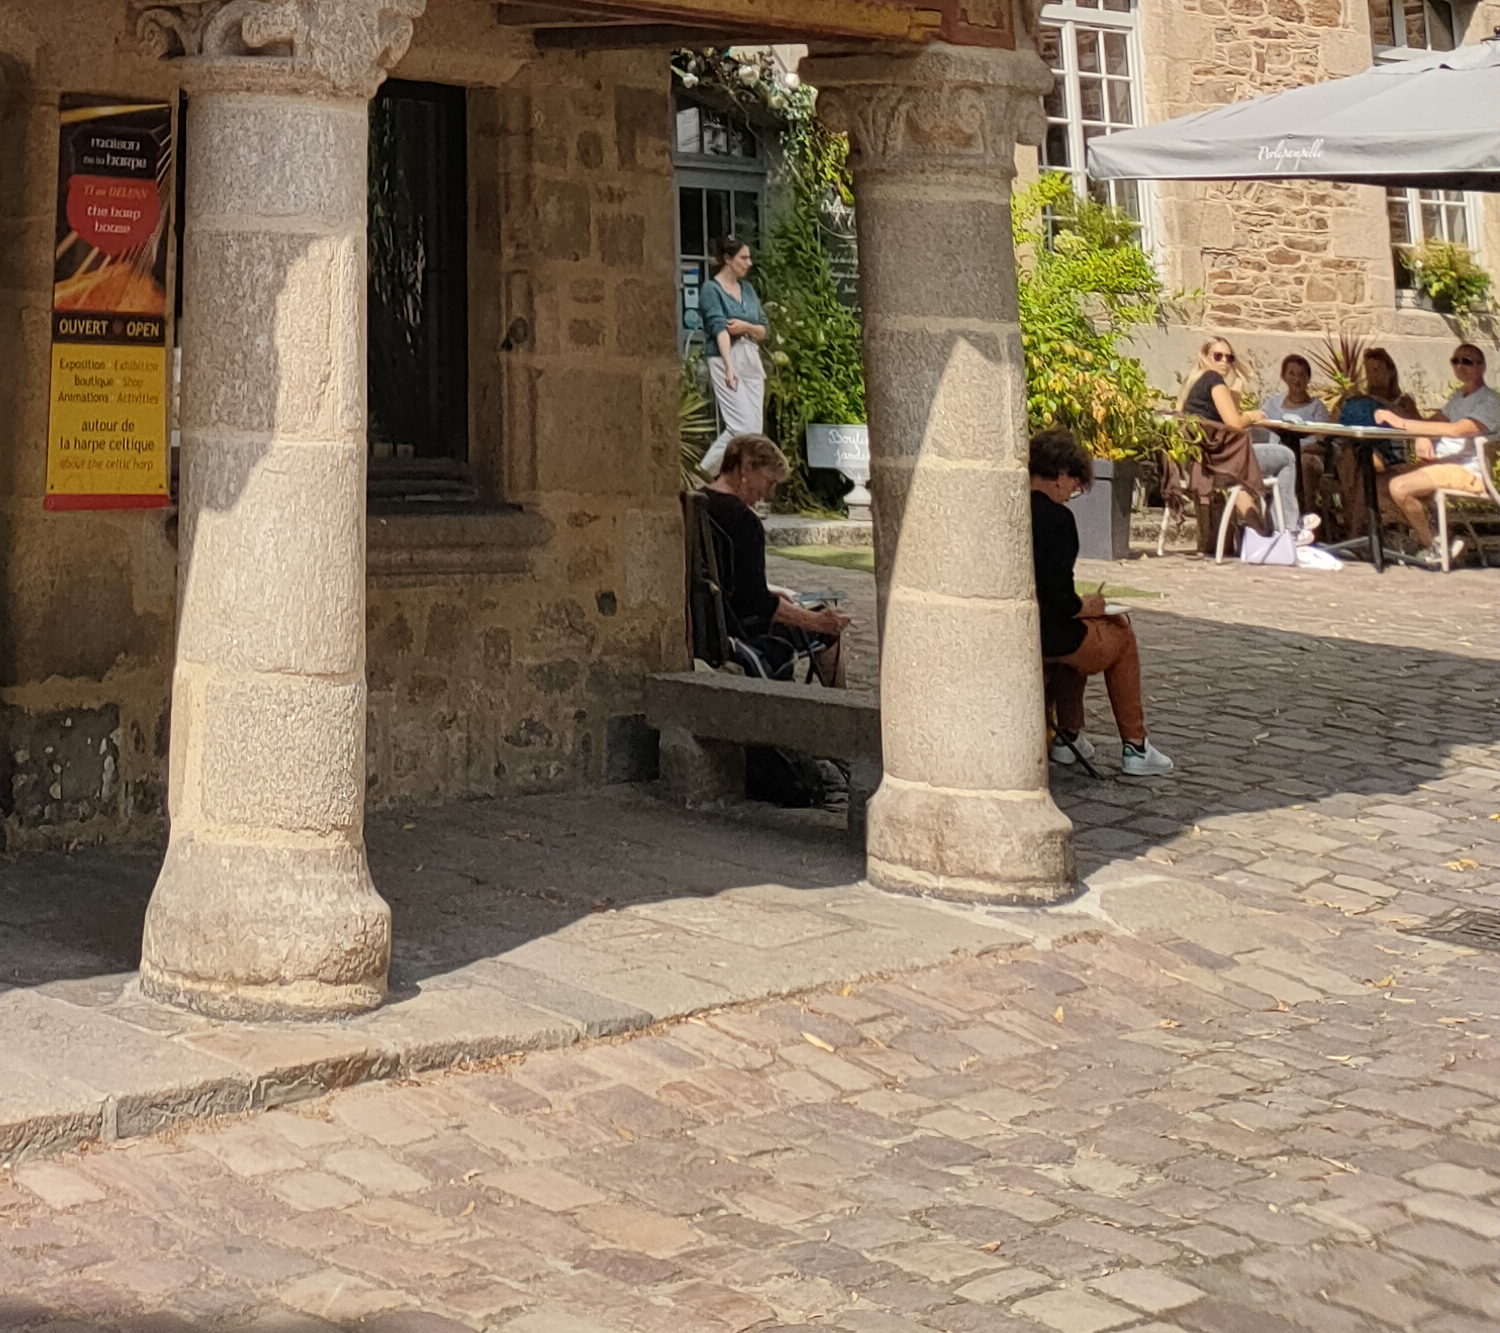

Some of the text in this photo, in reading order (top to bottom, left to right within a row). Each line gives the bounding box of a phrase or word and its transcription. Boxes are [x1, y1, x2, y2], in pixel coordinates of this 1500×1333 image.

[91, 137, 140, 151] maison
[106, 153, 147, 170] harpe
[87, 205, 141, 221] the harp
[95, 220, 131, 233] house
[59, 318, 159, 337] OUVERT OPEN
[59, 358, 159, 372] Exposition Exhibition
[74, 374, 144, 390] Boutique Shop
[58, 390, 159, 404] Animations Activities
[81, 418, 135, 432] autour de
[60, 436, 155, 454] la harpe celtique
[60, 457, 154, 471] about the celtic harp
